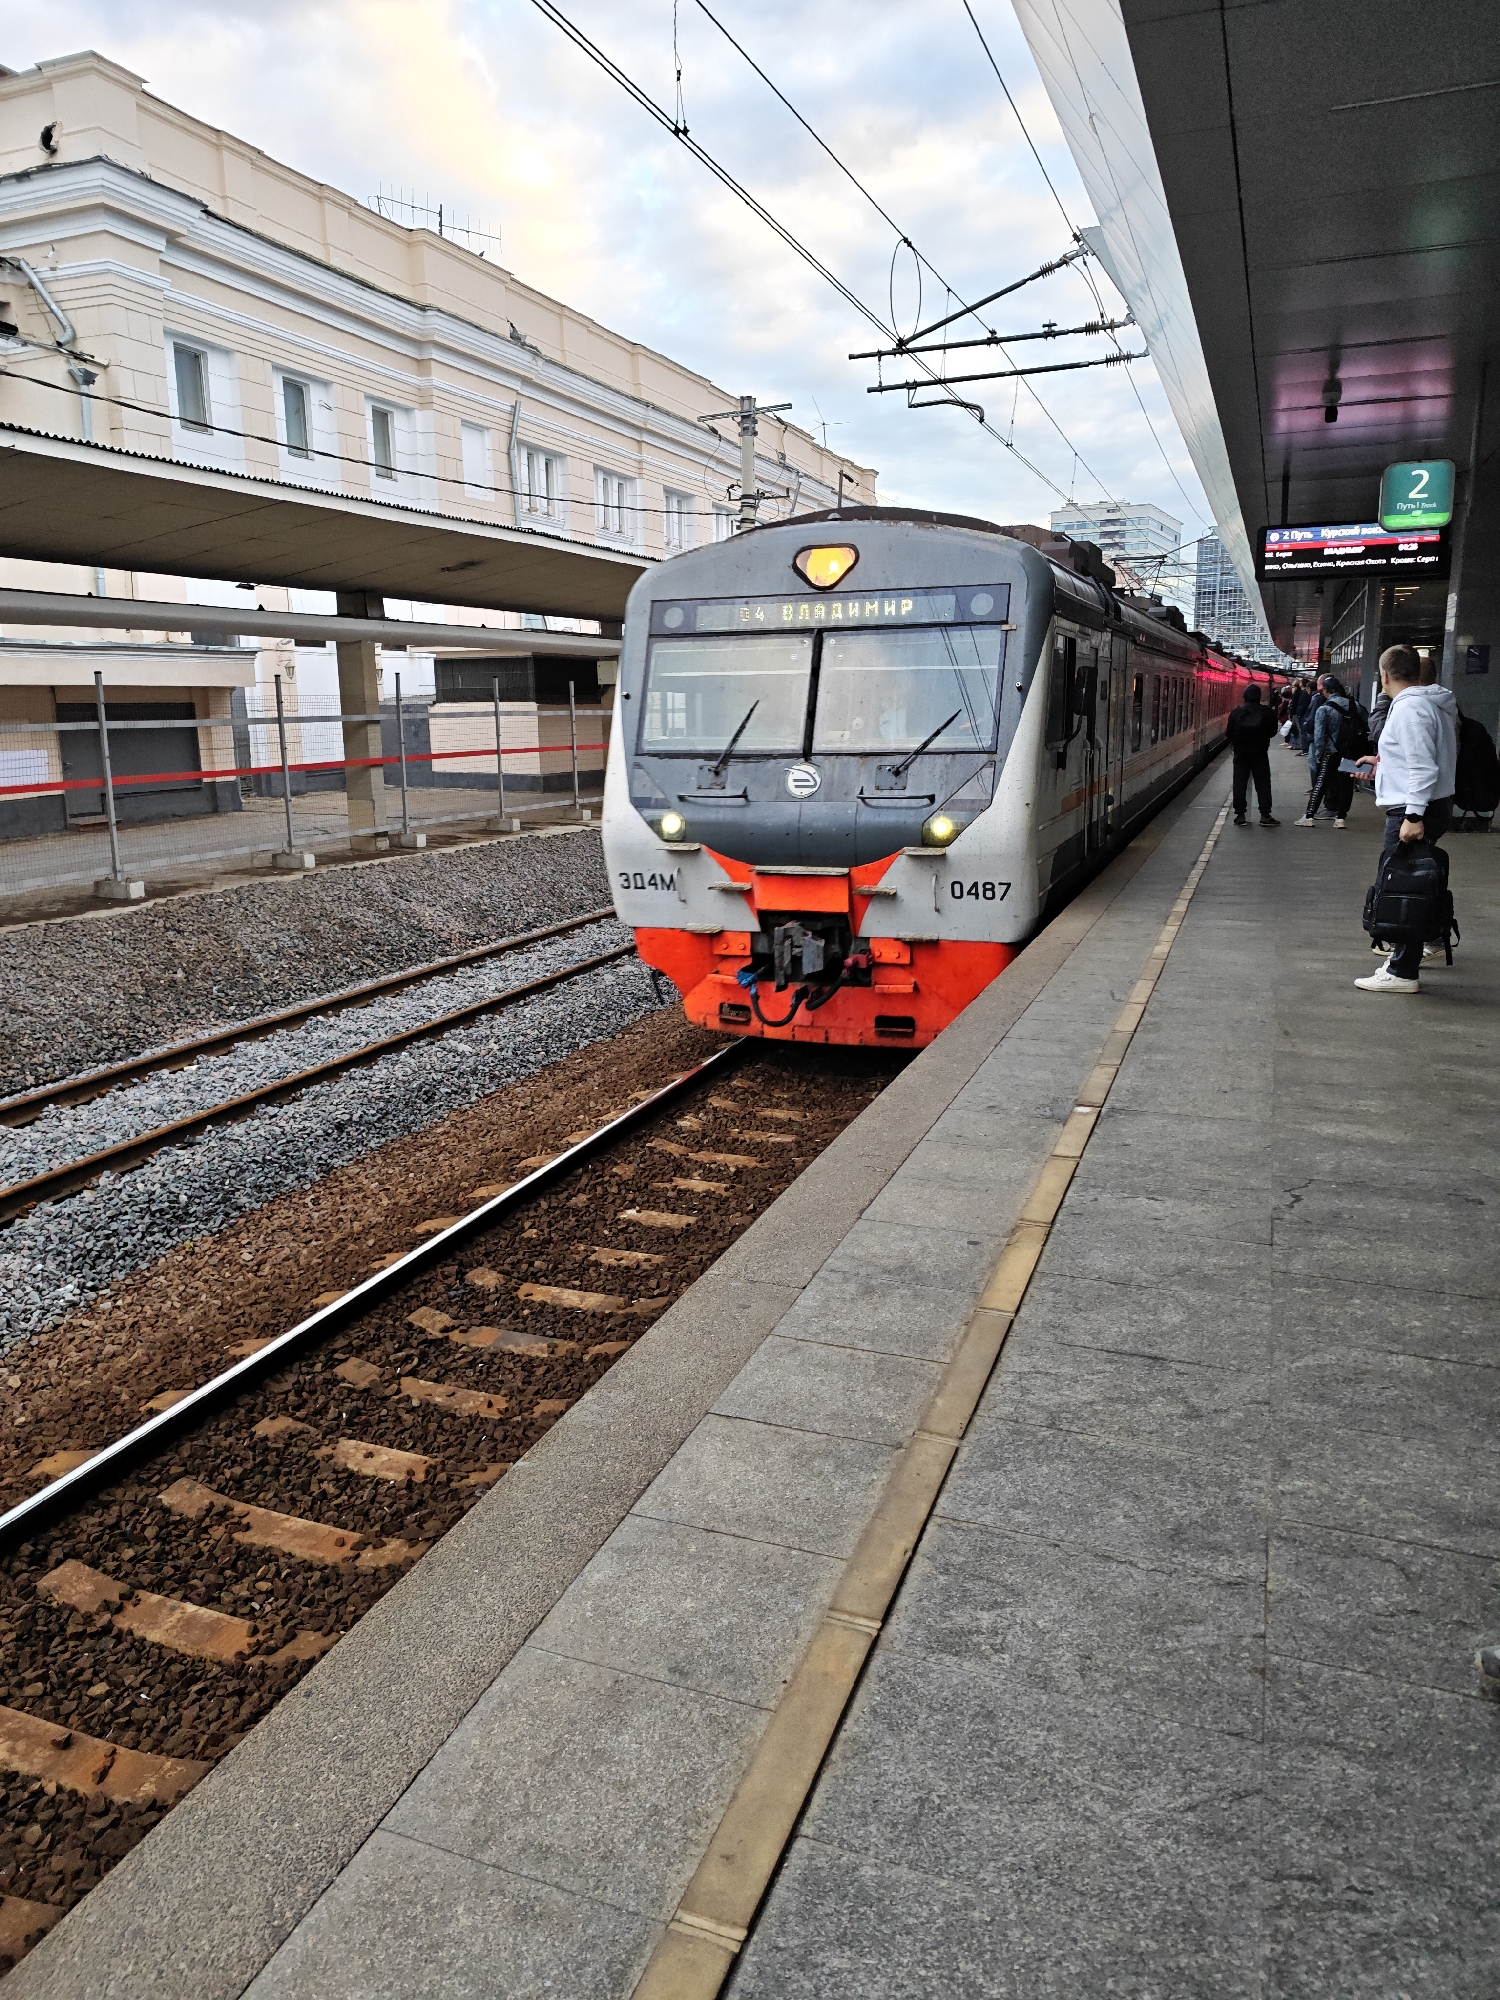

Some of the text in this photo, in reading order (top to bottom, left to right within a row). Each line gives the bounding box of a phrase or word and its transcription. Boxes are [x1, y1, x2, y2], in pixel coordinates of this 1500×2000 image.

[1408, 469, 1430, 499] 2
[1396, 502, 1416, 511] Путь
[1282, 531, 1290, 540] 2
[1290, 530, 1314, 541] Путь
[782, 599, 913, 621] ВЛАДИМИР
[619, 871, 678, 893] ЭД4М
[950, 880, 1012, 902] 0487
